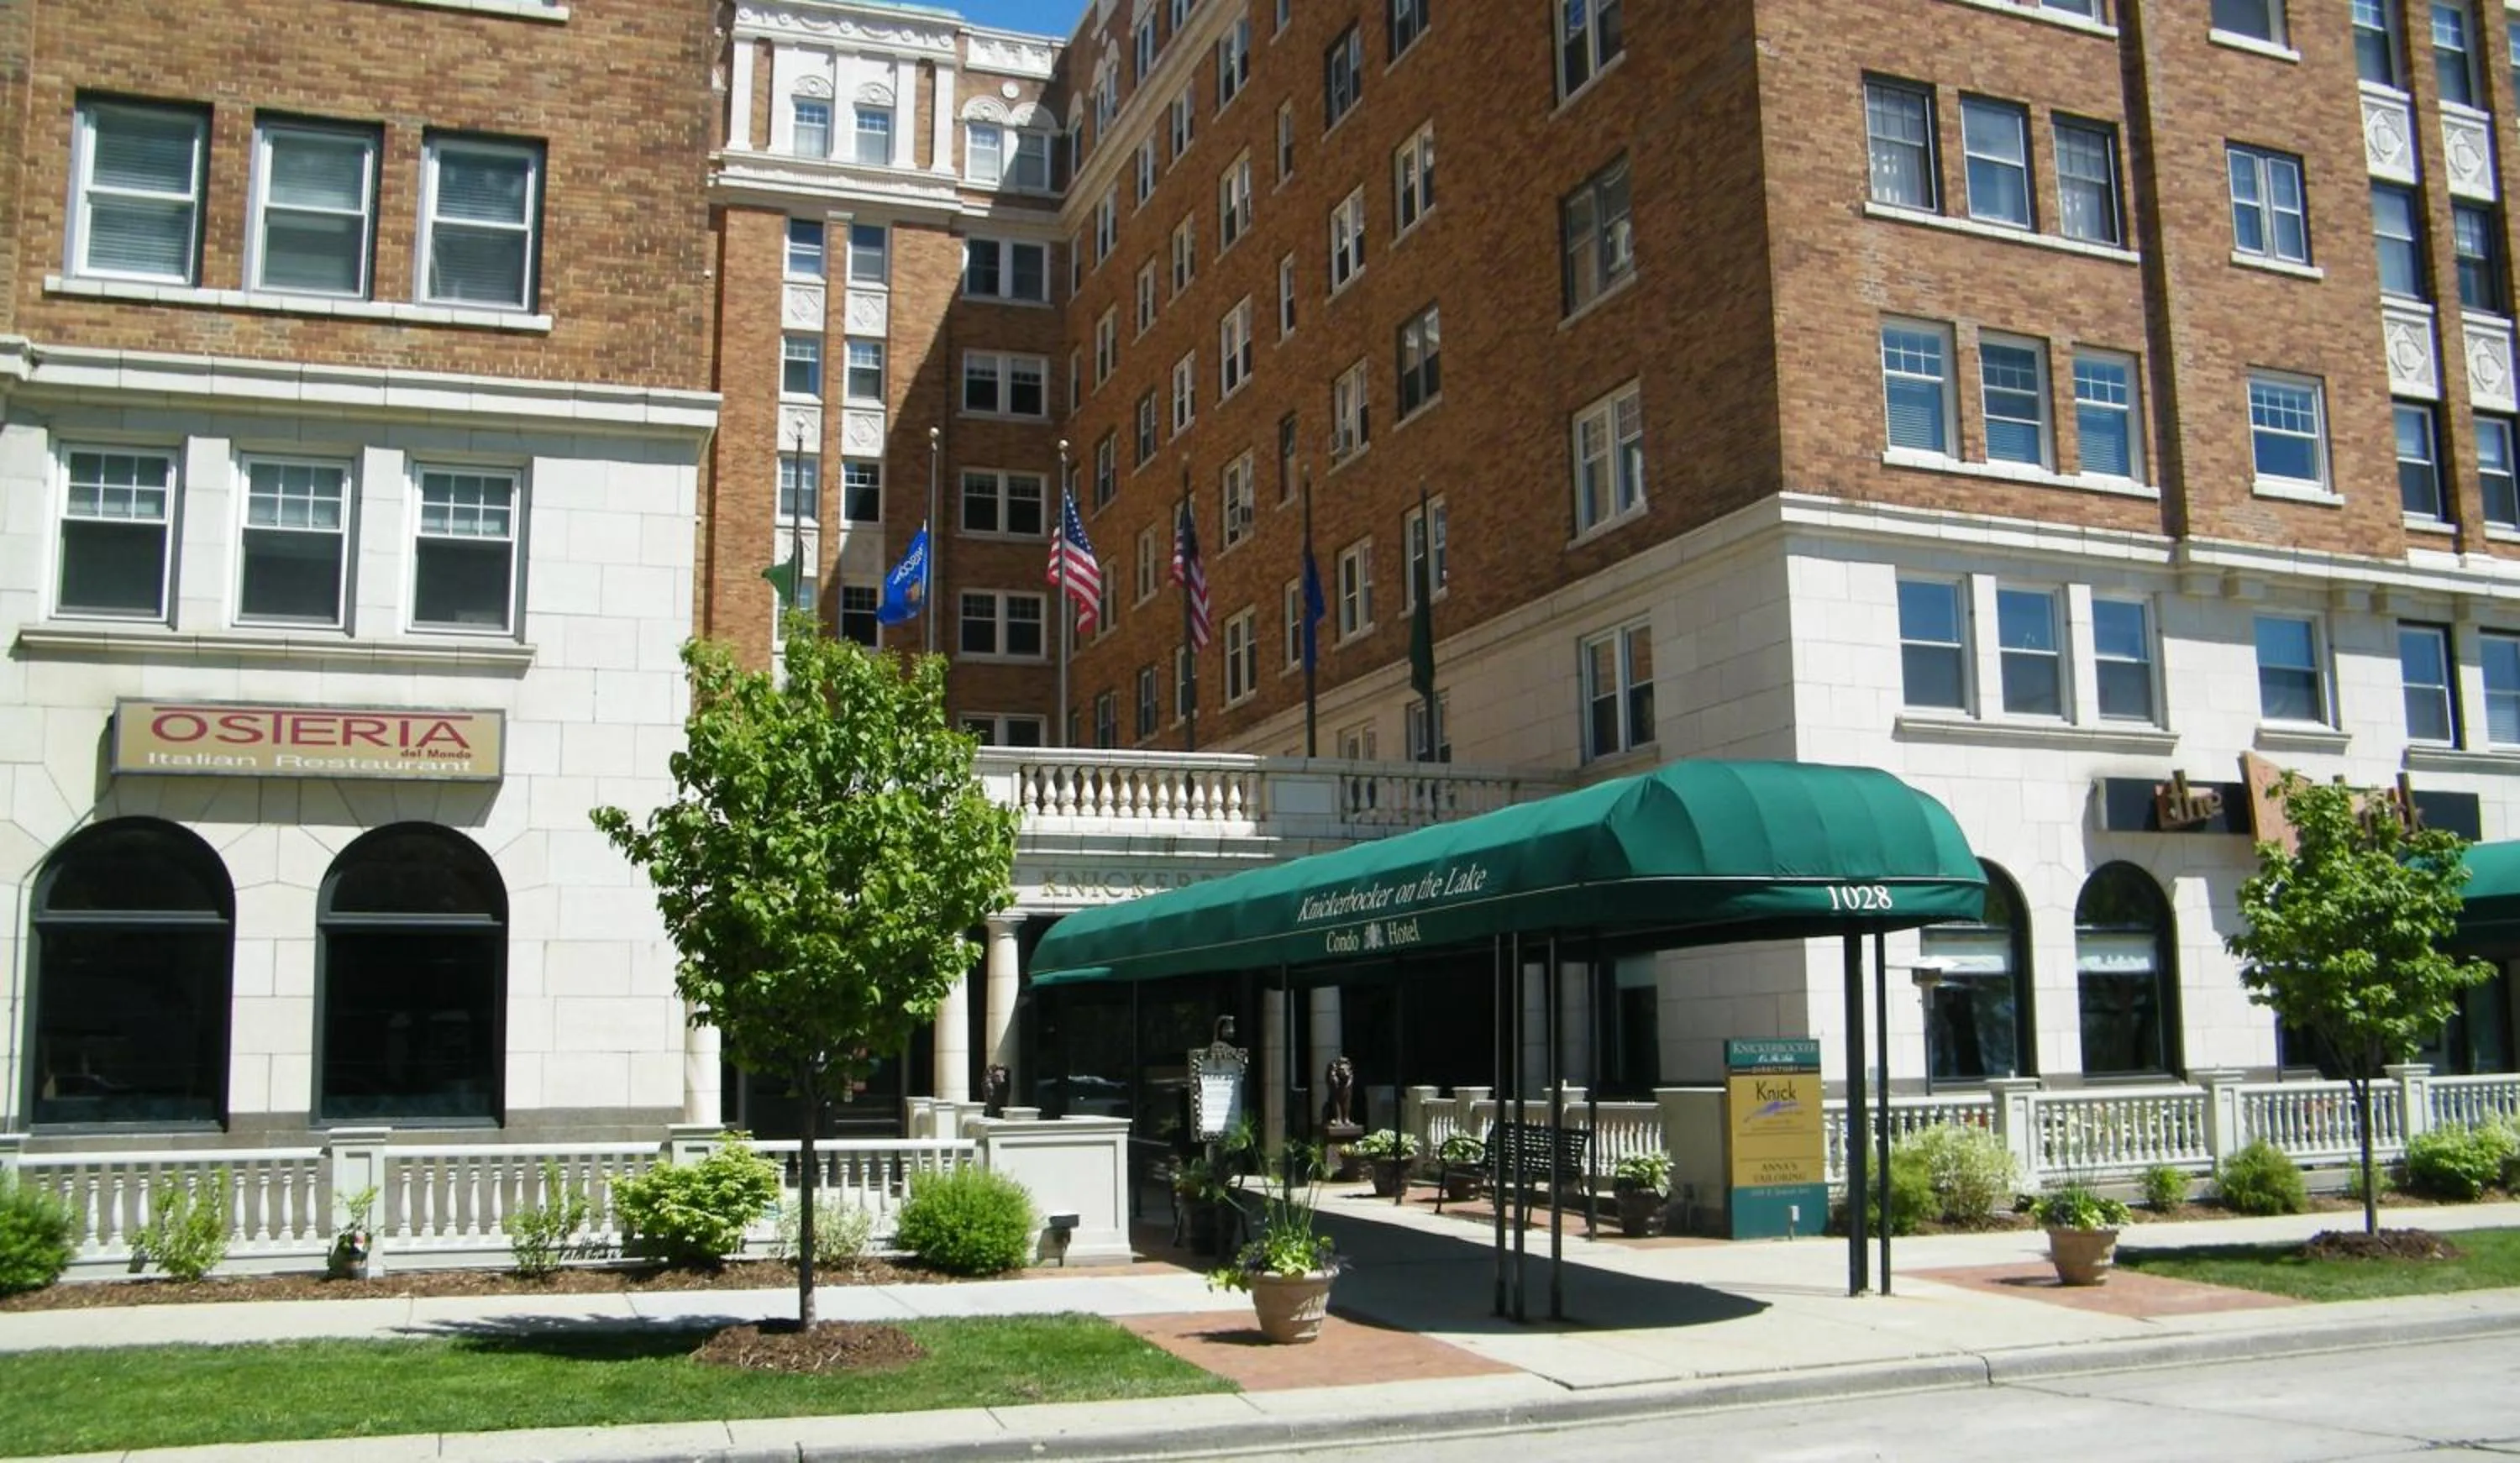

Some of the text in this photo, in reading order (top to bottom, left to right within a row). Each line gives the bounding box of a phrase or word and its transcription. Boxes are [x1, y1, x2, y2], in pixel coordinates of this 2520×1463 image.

[151, 706, 473, 749] OSTERIA
[147, 751, 471, 773] Italian Restaurant
[401, 748, 422, 758] del
[1297, 863, 1488, 924] Knickerbocker on the Lake
[1826, 884, 1893, 910] 1028
[1326, 917, 1421, 952] Condo Hotel
[1756, 1079, 1797, 1102] Knick
